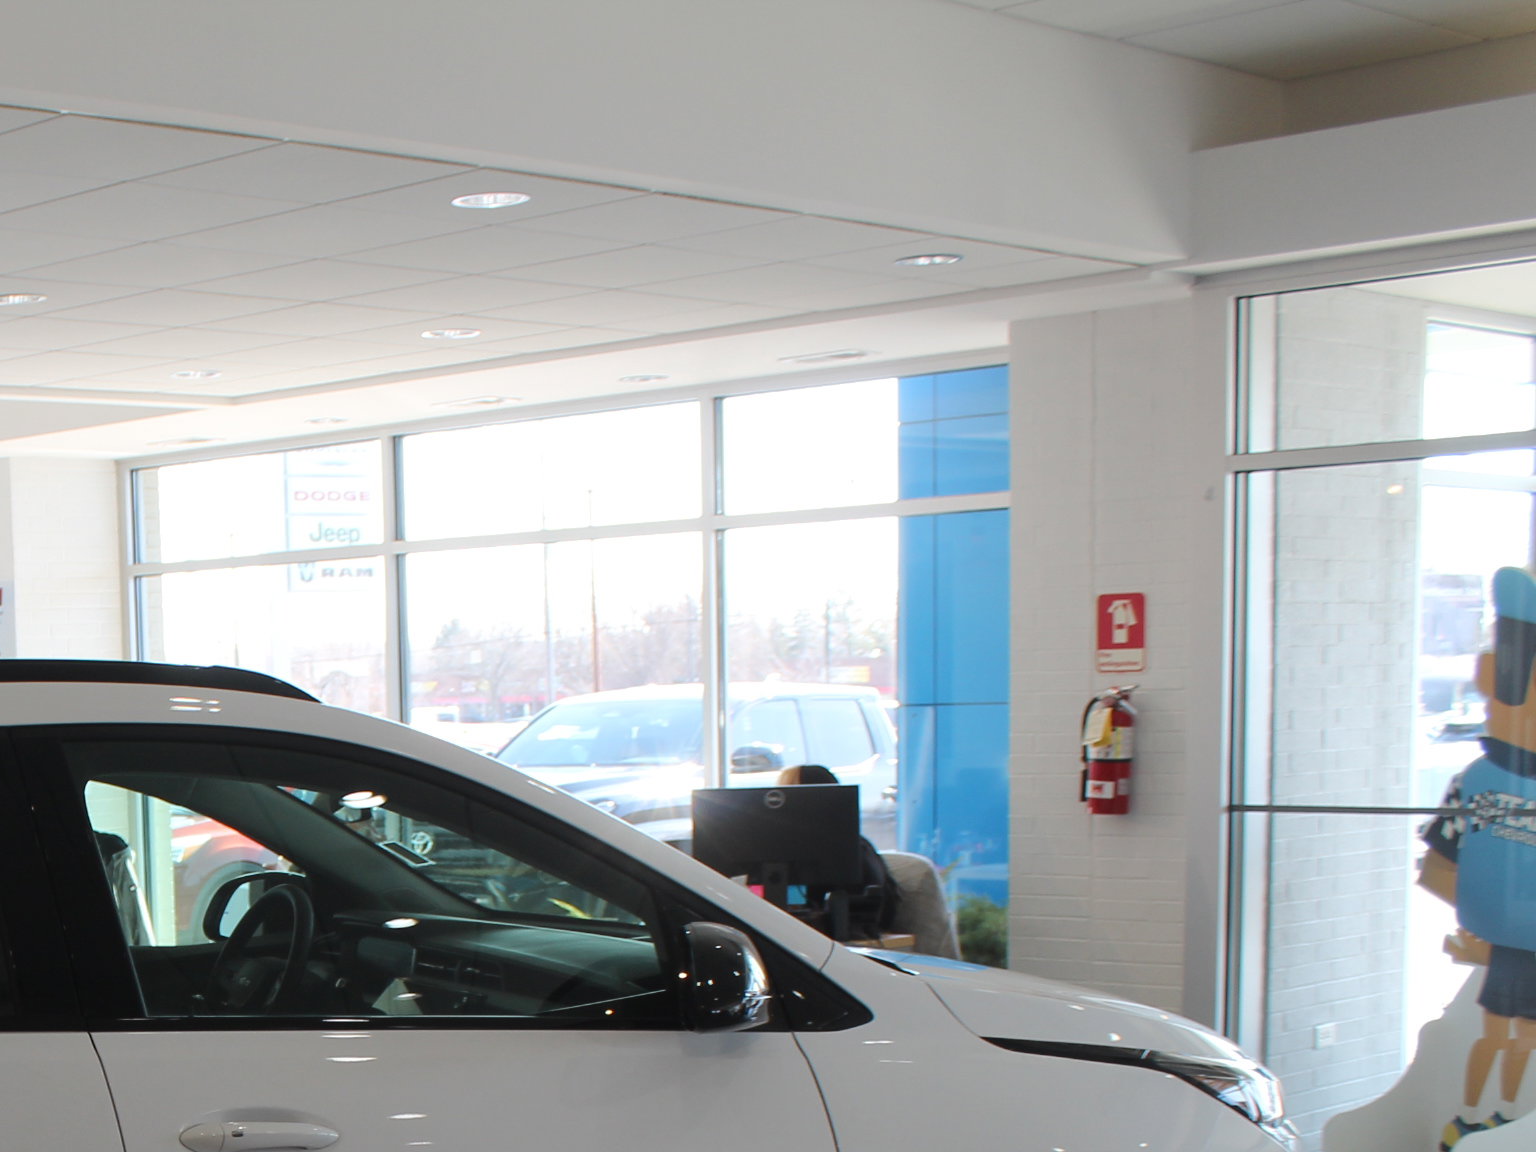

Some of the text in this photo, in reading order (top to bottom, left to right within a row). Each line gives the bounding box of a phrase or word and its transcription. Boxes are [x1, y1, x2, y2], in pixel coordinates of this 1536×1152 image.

[294, 491, 370, 501] DODGE
[309, 522, 360, 544] Jeep
[322, 568, 373, 577] RAM
